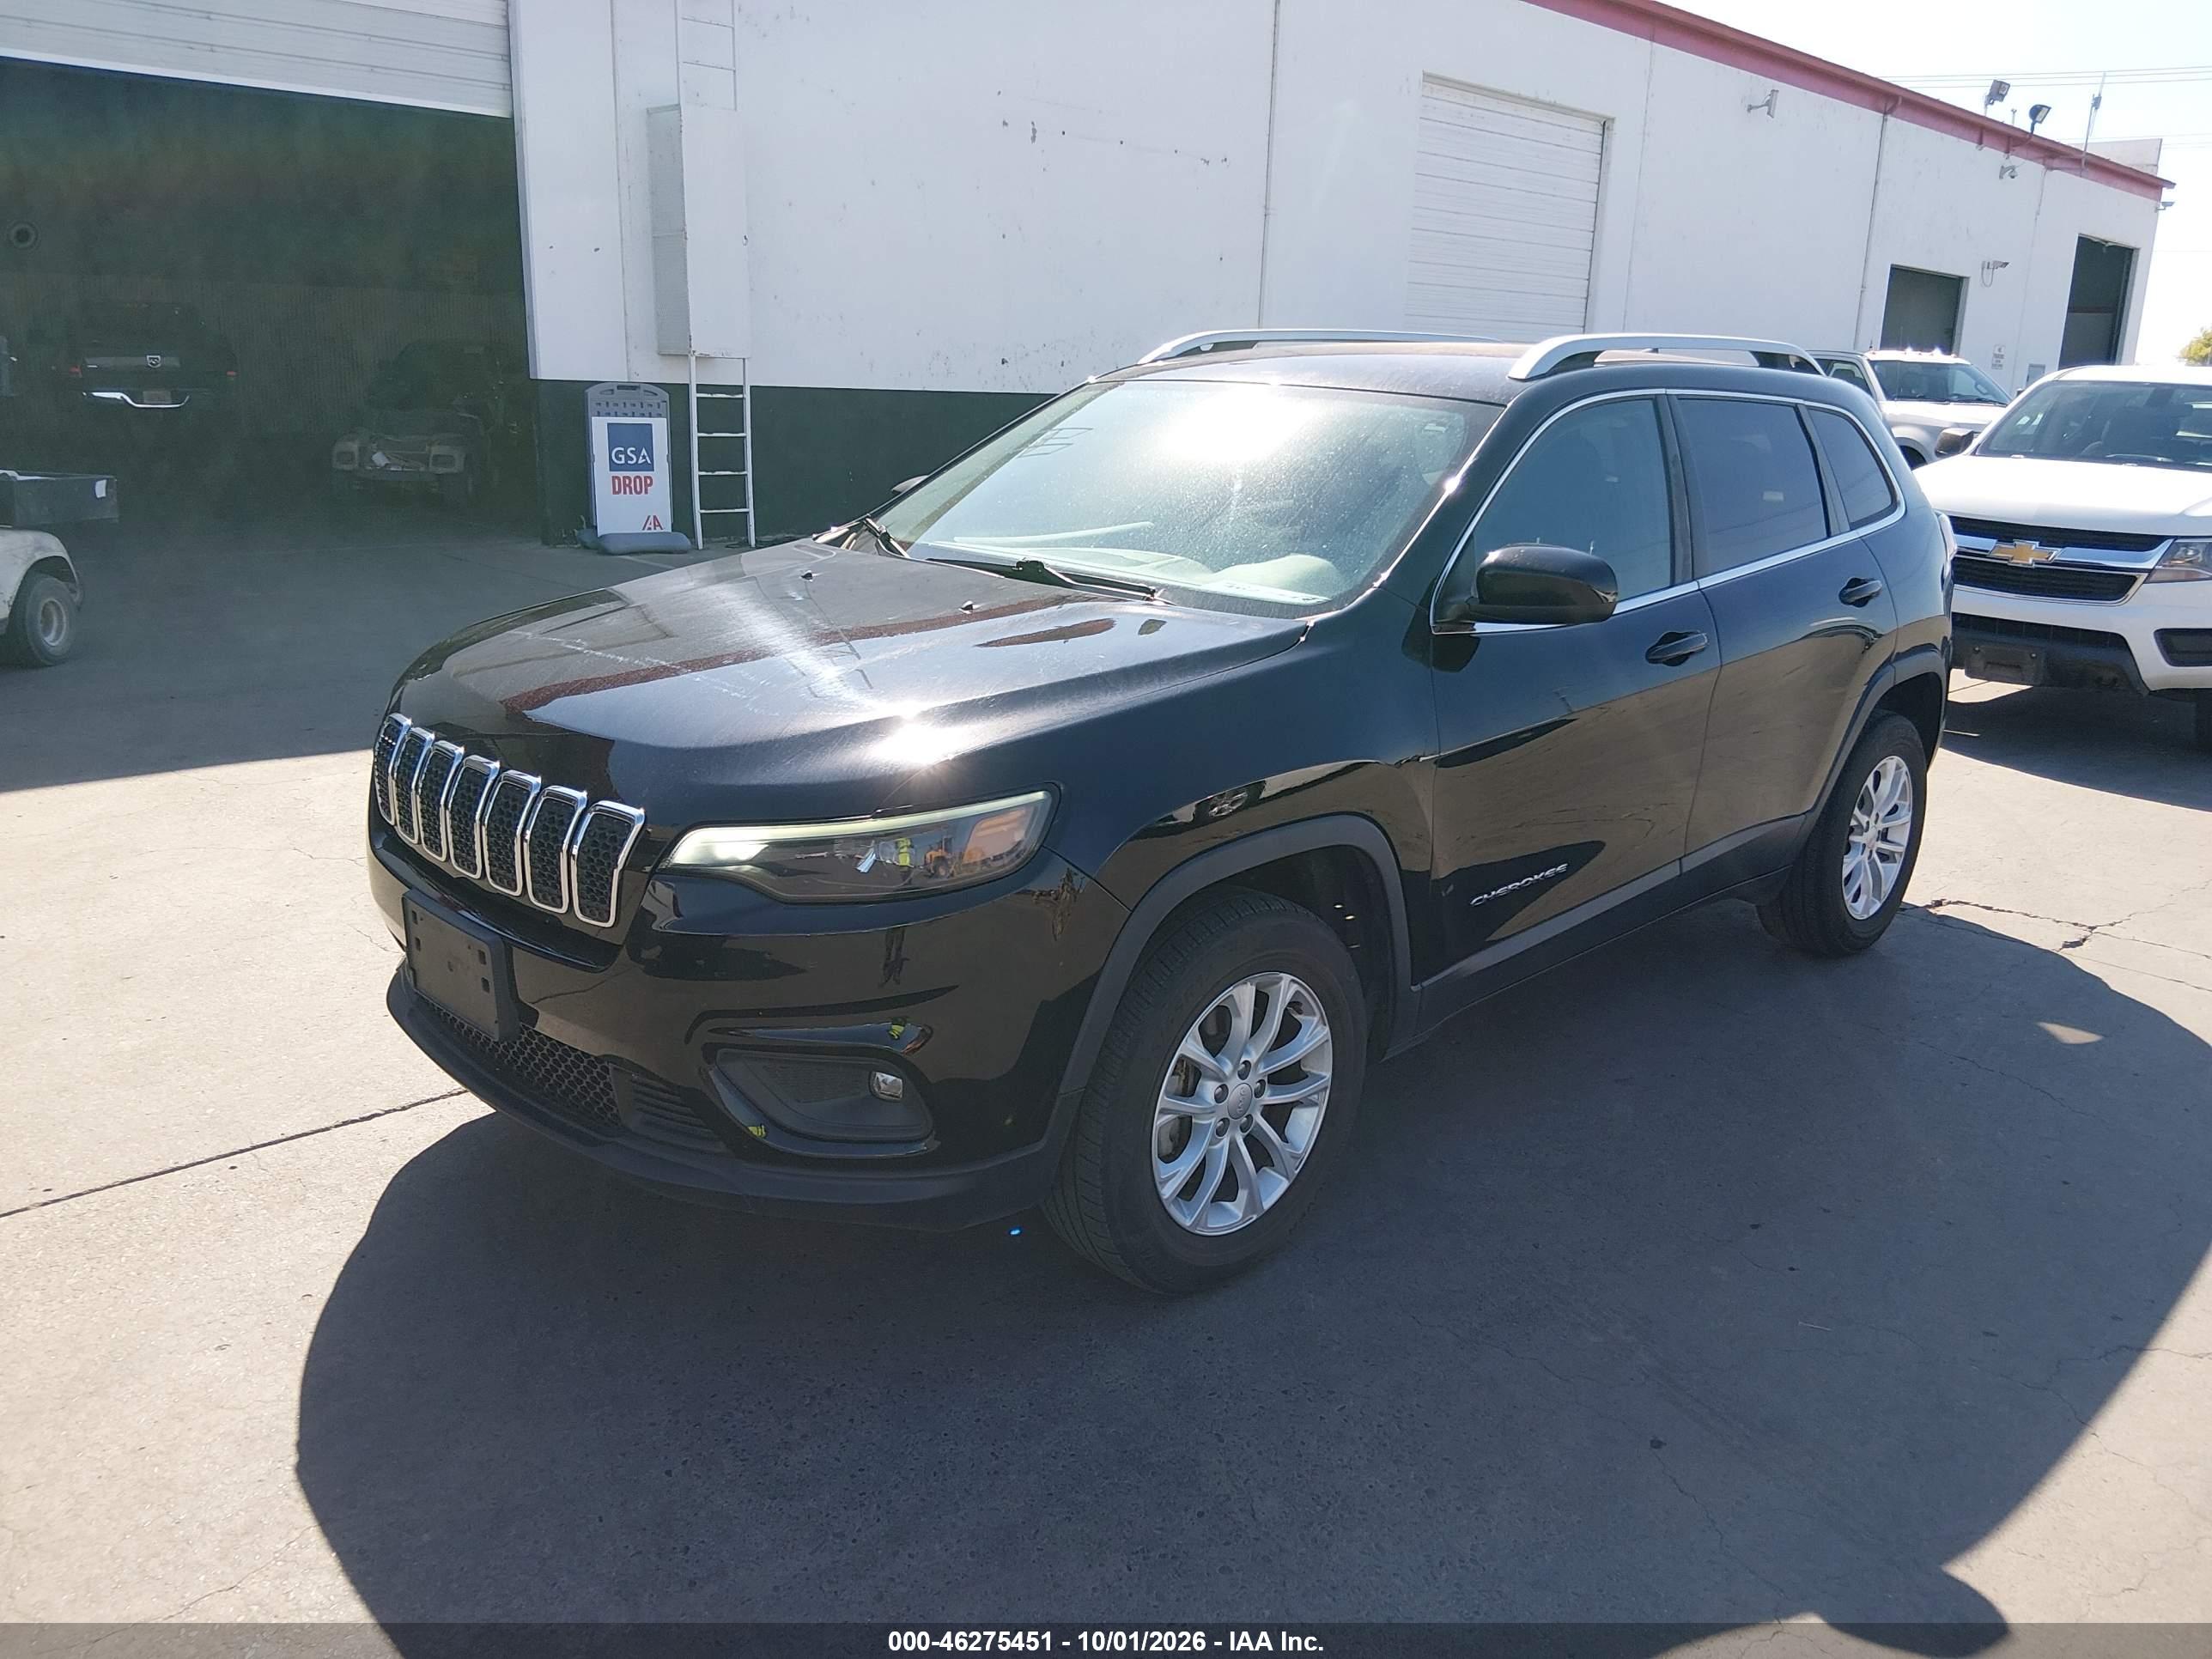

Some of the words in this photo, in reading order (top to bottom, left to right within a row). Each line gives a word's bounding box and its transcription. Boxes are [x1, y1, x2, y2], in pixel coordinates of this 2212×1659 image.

[611, 447, 652, 465] GSA
[611, 475, 653, 495] DROP
[1469, 863, 1569, 907] CHEROKEE
